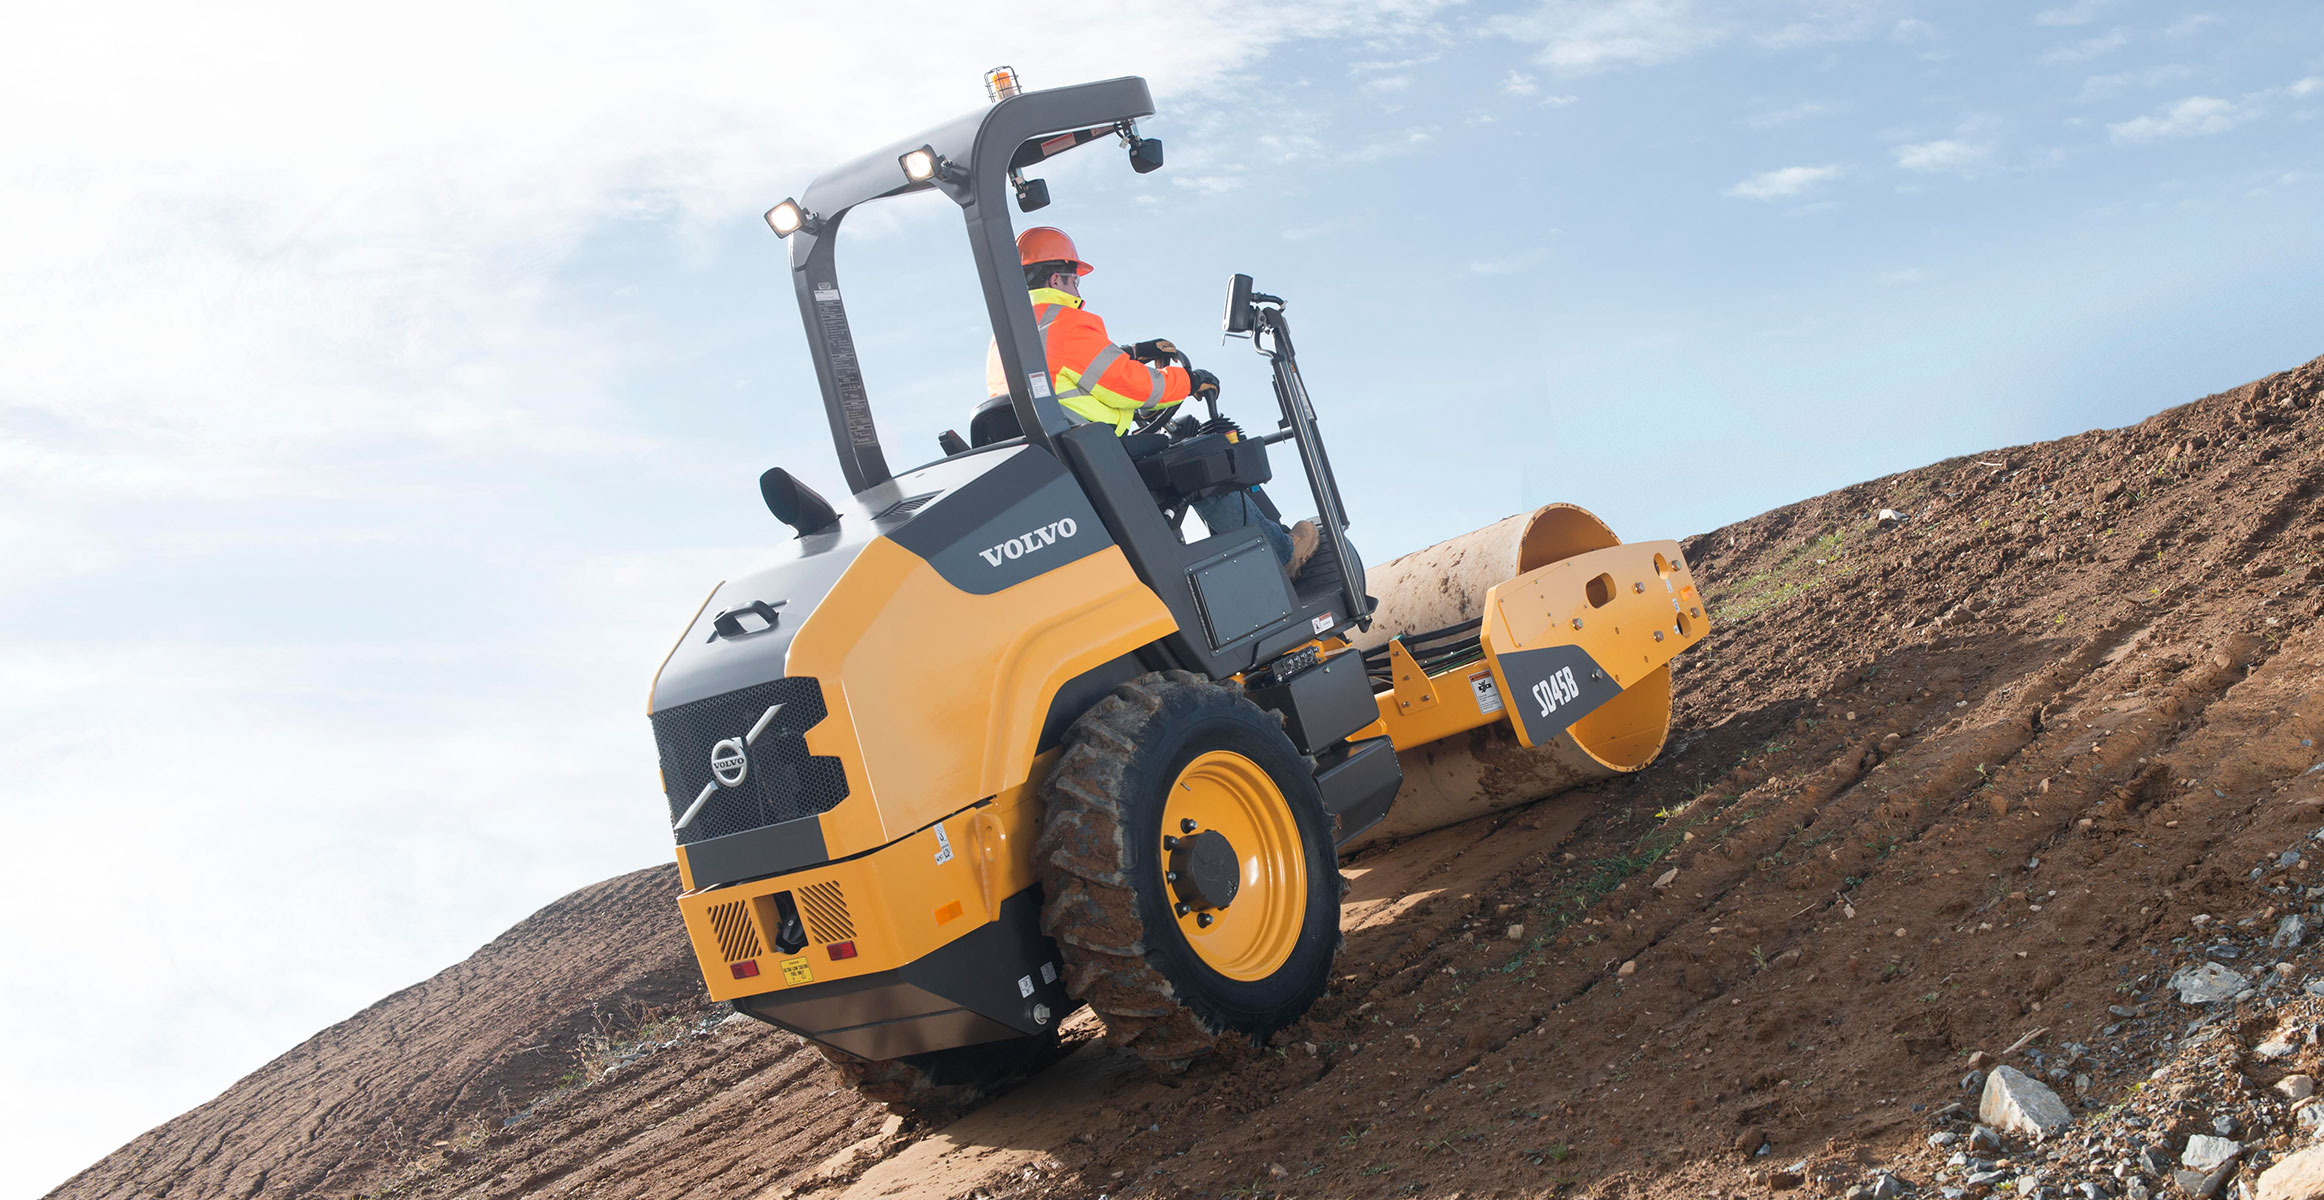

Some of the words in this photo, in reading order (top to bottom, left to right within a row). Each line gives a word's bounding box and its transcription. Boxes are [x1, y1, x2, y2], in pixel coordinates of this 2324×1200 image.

[979, 517, 1077, 567] VOLVO
[1532, 665, 1579, 718] SD45B
[713, 757, 744, 769] VOLVO
